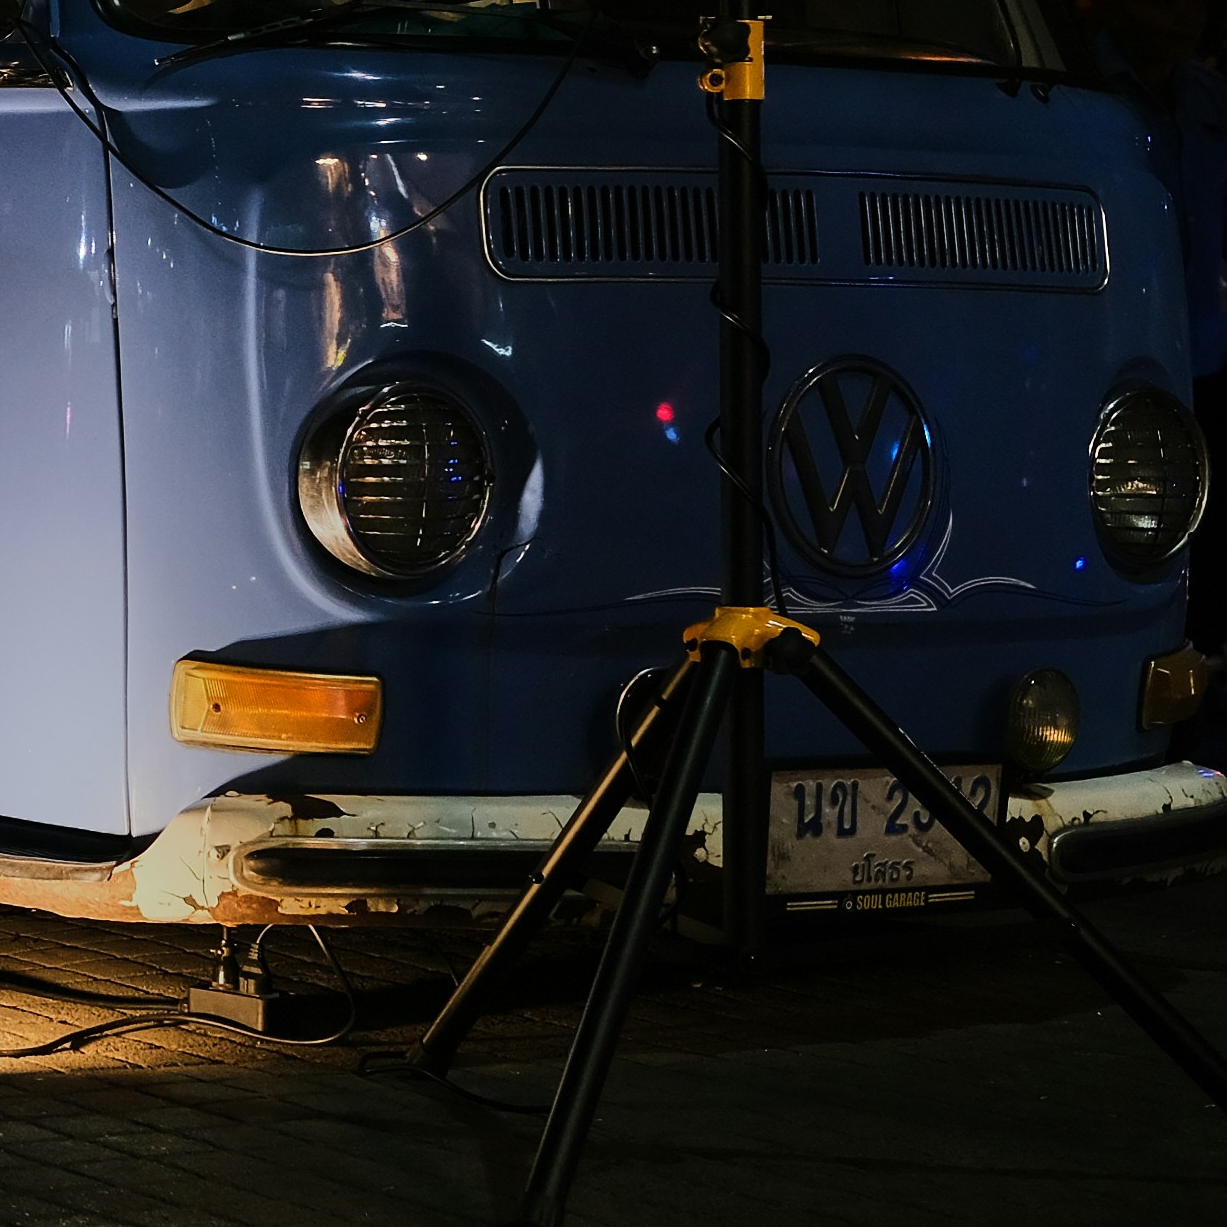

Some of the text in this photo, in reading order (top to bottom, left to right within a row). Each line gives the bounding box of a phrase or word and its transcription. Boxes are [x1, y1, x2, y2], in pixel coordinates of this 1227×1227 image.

[885, 775, 991, 835] 22
[852, 852, 915, 884] ยโสธร
[856, 890, 927, 911] SOUL GARAGE
